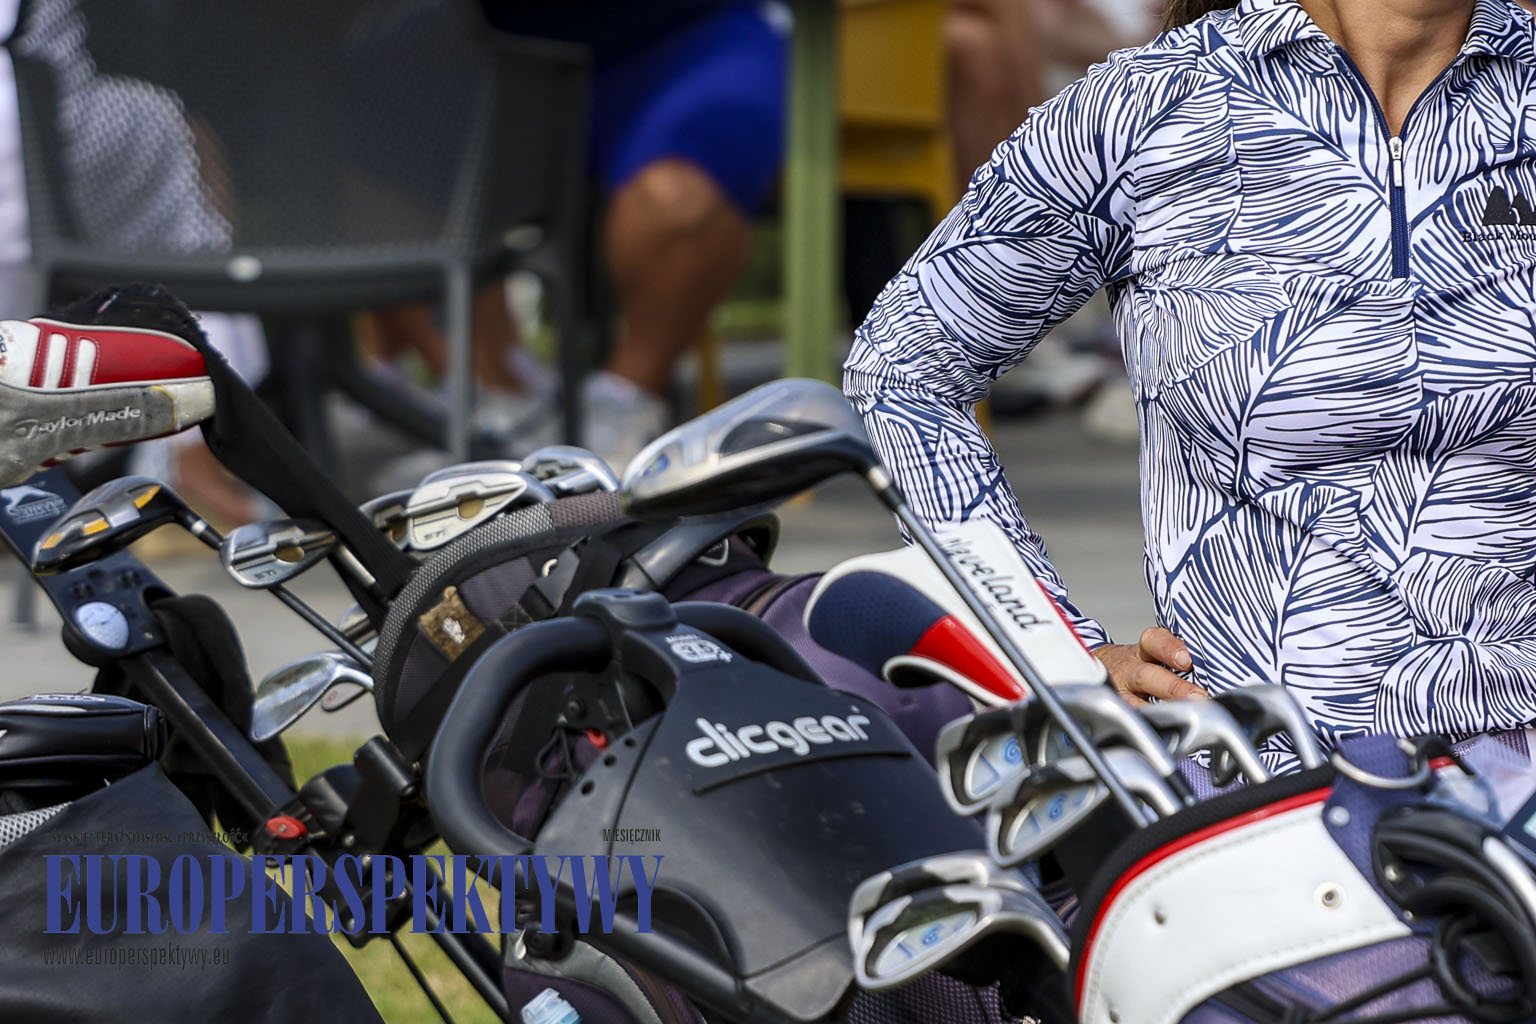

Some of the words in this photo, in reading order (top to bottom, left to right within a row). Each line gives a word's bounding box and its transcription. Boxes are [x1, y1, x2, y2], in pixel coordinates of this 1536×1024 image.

[1462, 231, 1504, 243] Black
[14, 406, 141, 440] TaylorMade
[686, 715, 871, 768] clicgear
